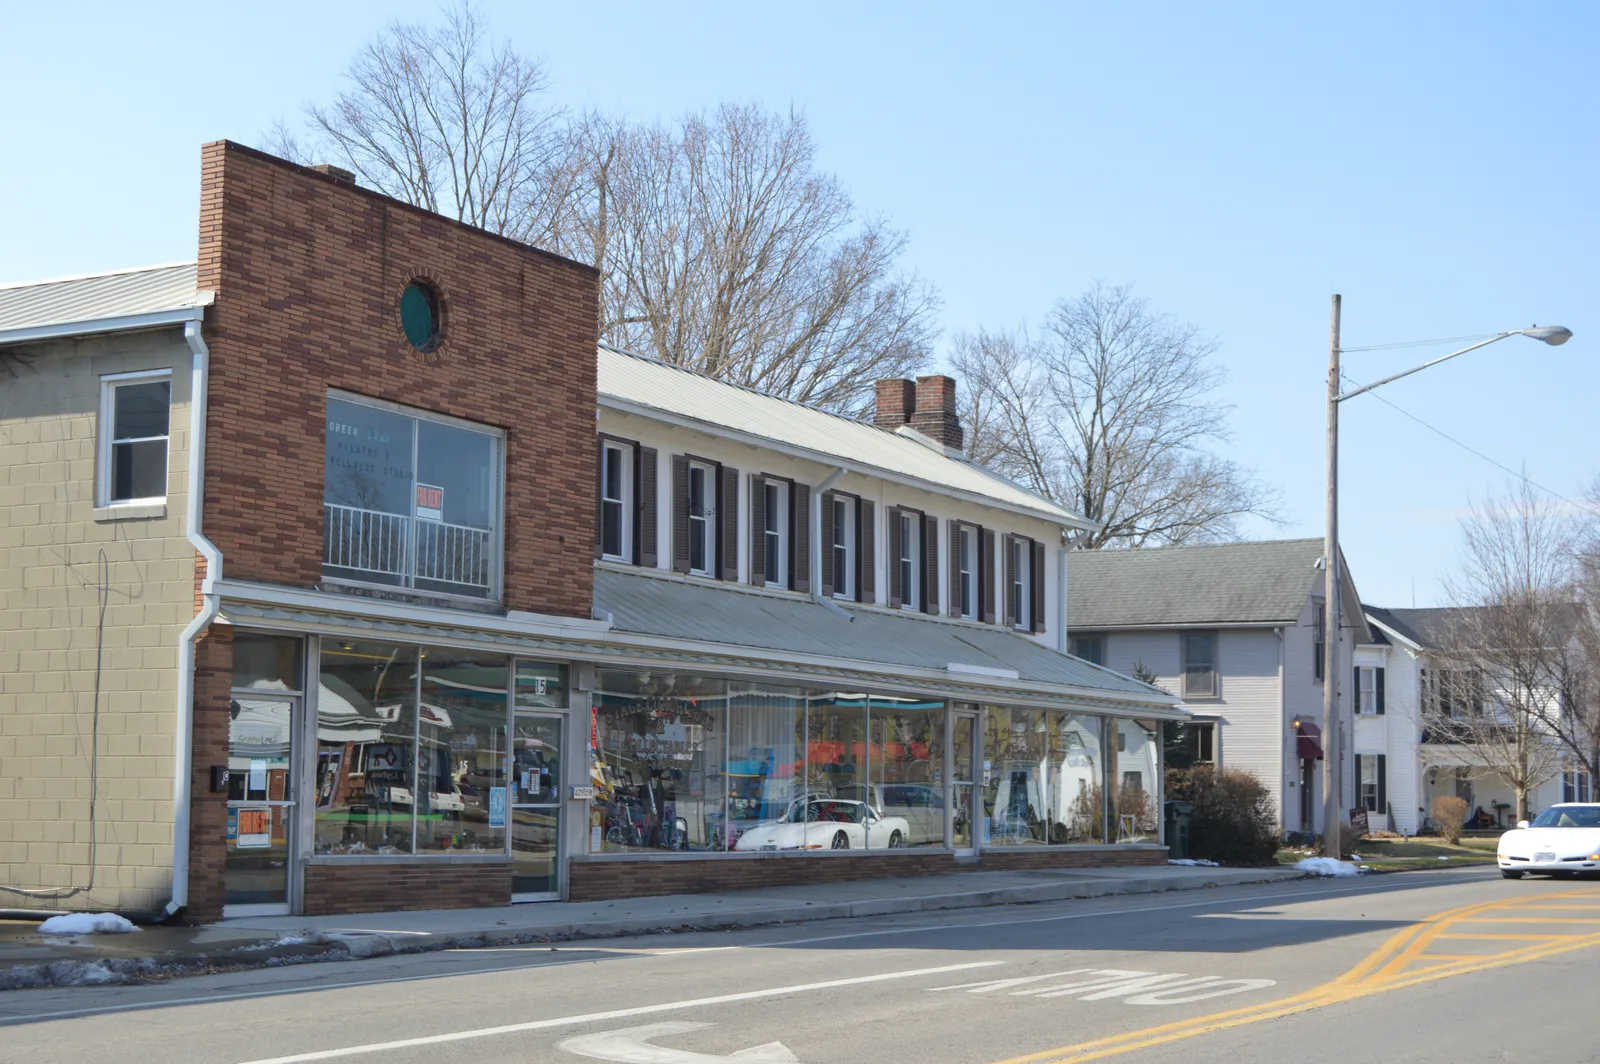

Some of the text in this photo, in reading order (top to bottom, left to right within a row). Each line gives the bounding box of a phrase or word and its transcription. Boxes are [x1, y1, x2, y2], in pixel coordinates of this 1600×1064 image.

[329, 421, 358, 436] GREEN
[338, 441, 379, 458] PILATES
[330, 456, 414, 480] WELLNESS STUDIO
[535, 677, 546, 694] 15
[924, 968, 1277, 1006] ONLY
